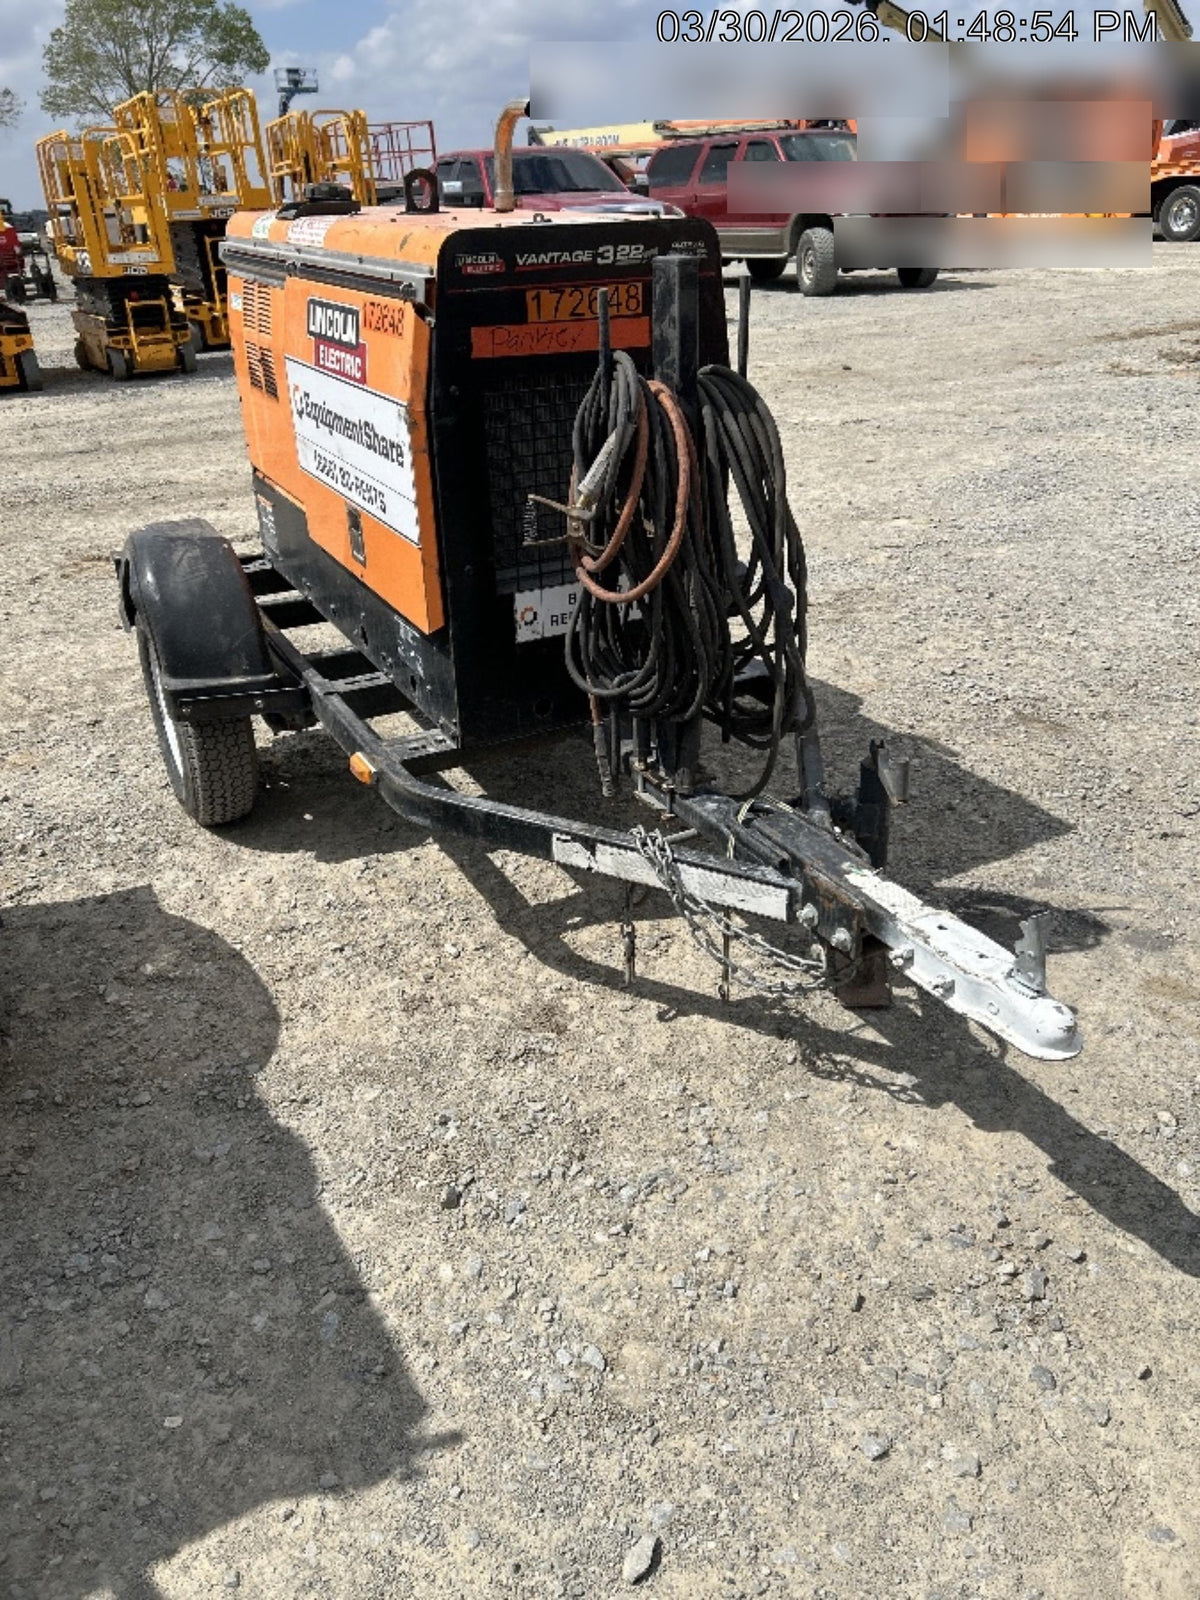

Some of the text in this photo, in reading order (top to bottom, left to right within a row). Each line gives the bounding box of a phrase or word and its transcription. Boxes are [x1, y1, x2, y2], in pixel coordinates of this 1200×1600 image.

[515, 250, 594, 266] VANTAGE
[597, 245, 644, 266] 322
[530, 284, 642, 321] 172648
[308, 299, 357, 345] LINCOLN
[319, 344, 362, 380] ELECTRIC
[302, 392, 405, 469] EquipmentShare
